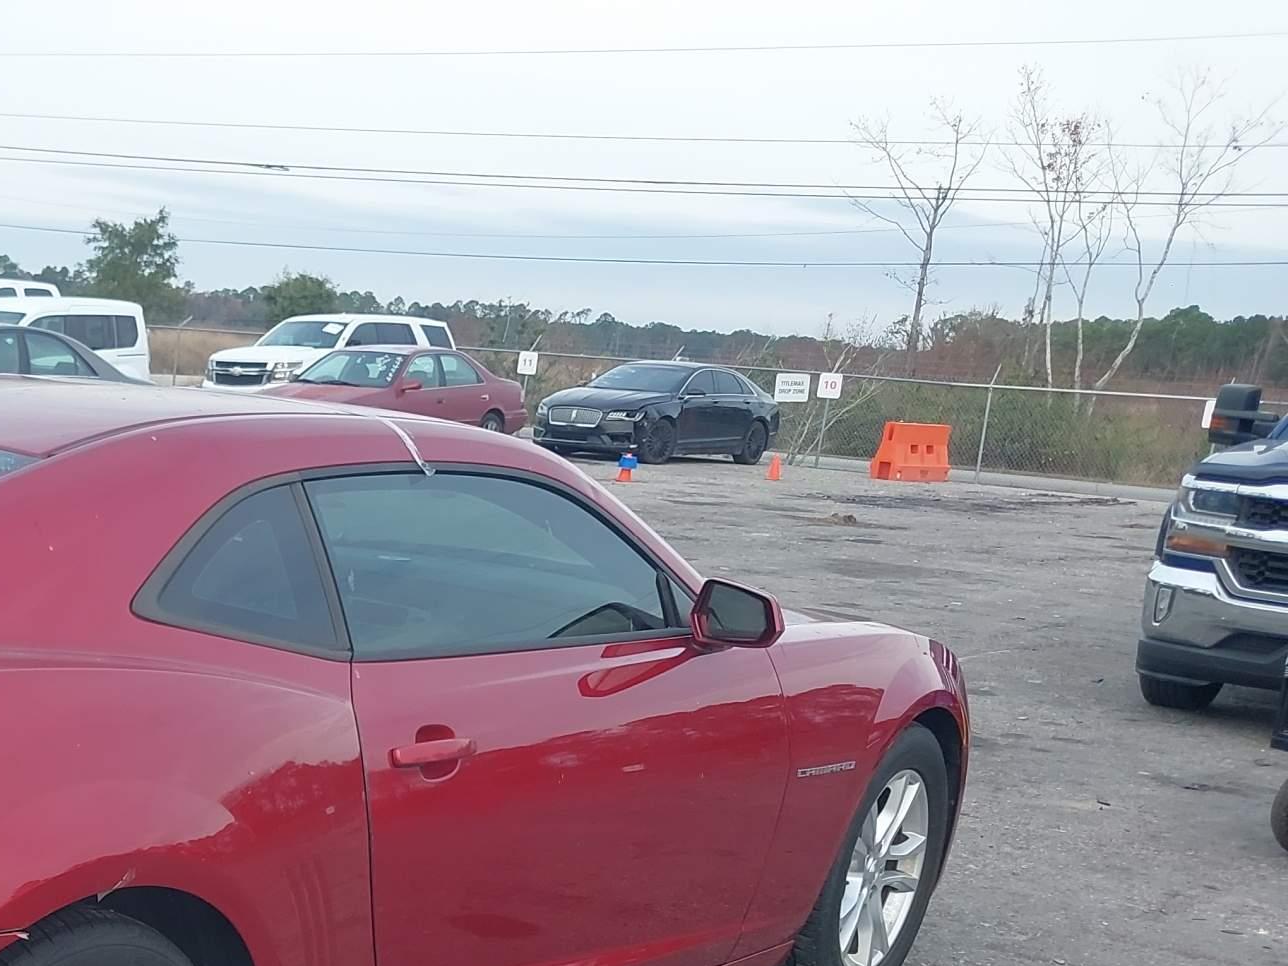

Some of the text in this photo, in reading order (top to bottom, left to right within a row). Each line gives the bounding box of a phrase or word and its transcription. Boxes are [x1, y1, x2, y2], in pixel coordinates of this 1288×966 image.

[523, 359, 532, 367] 11
[824, 381, 837, 390] 10
[797, 761, 856, 778] CAMARO
